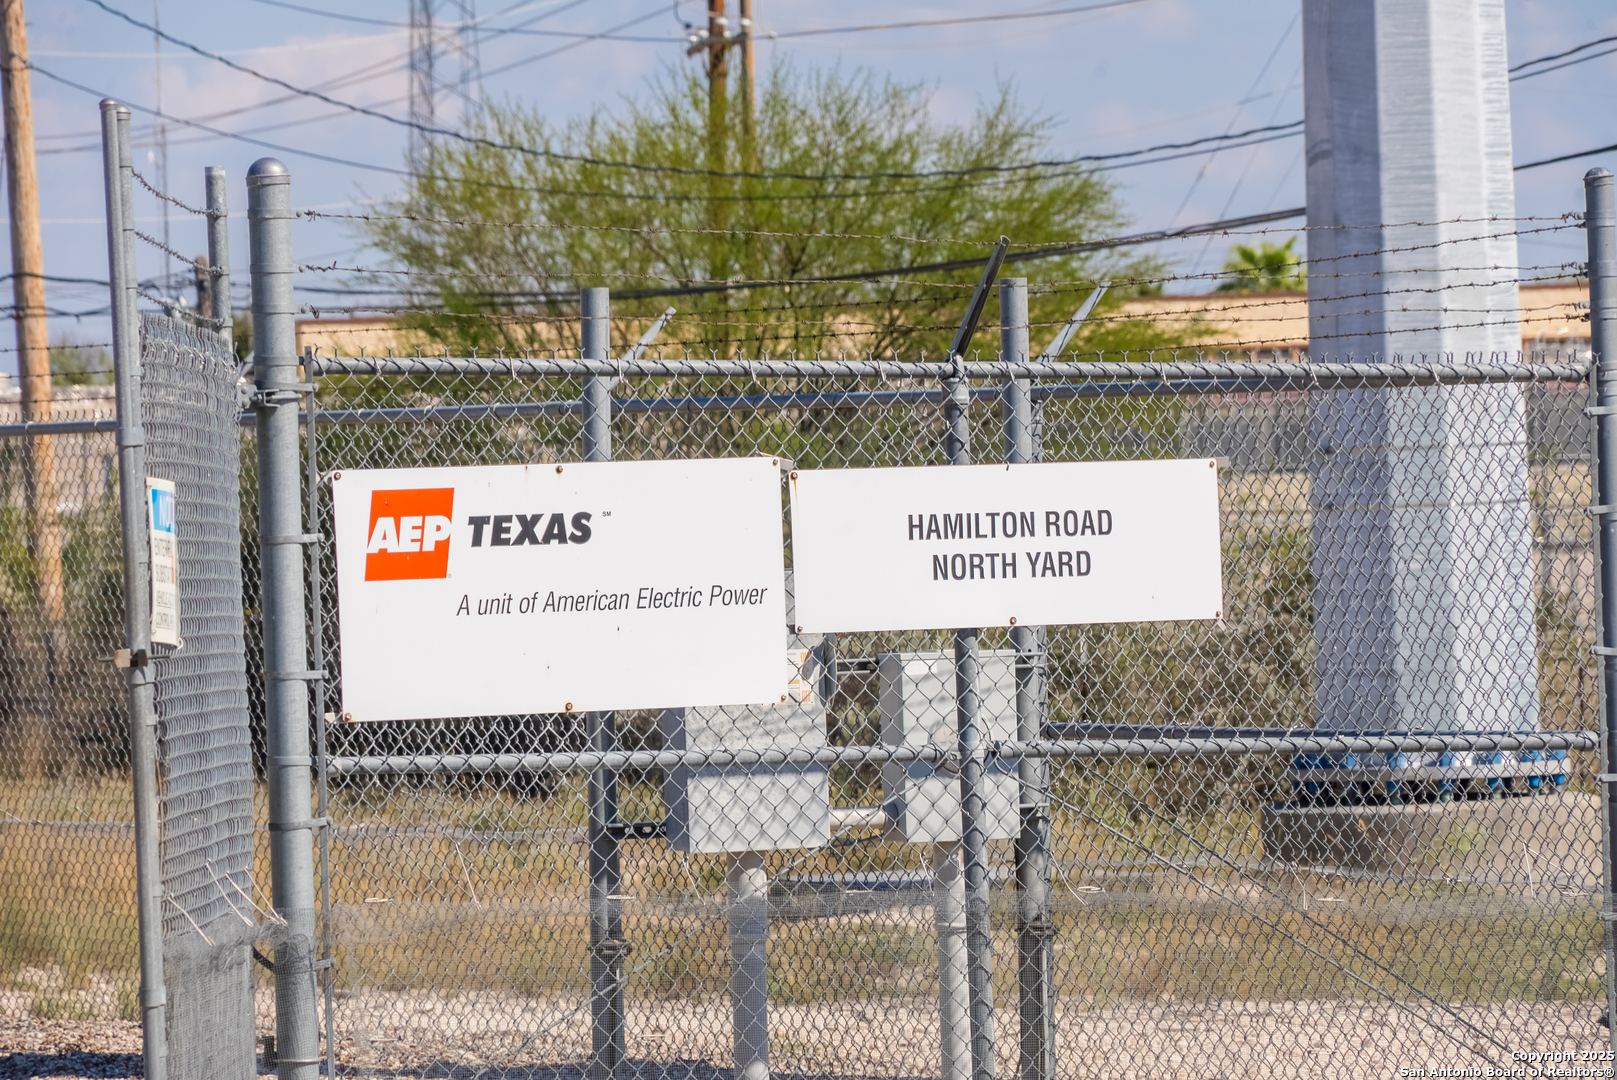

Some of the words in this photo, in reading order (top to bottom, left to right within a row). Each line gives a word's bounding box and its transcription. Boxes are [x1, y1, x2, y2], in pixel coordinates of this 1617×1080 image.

[366, 515, 452, 554] AEP
[467, 511, 593, 548] TEXAS
[908, 511, 1036, 541] HAMILTON
[1045, 509, 1113, 537] ROAD
[932, 552, 1017, 581] NORTH
[1025, 550, 1091, 578] YARD
[457, 595, 470, 616] A
[478, 593, 513, 616] unit
[520, 591, 539, 613] of
[543, 589, 630, 612] American
[637, 585, 703, 609] Electric
[709, 584, 768, 606] Power
